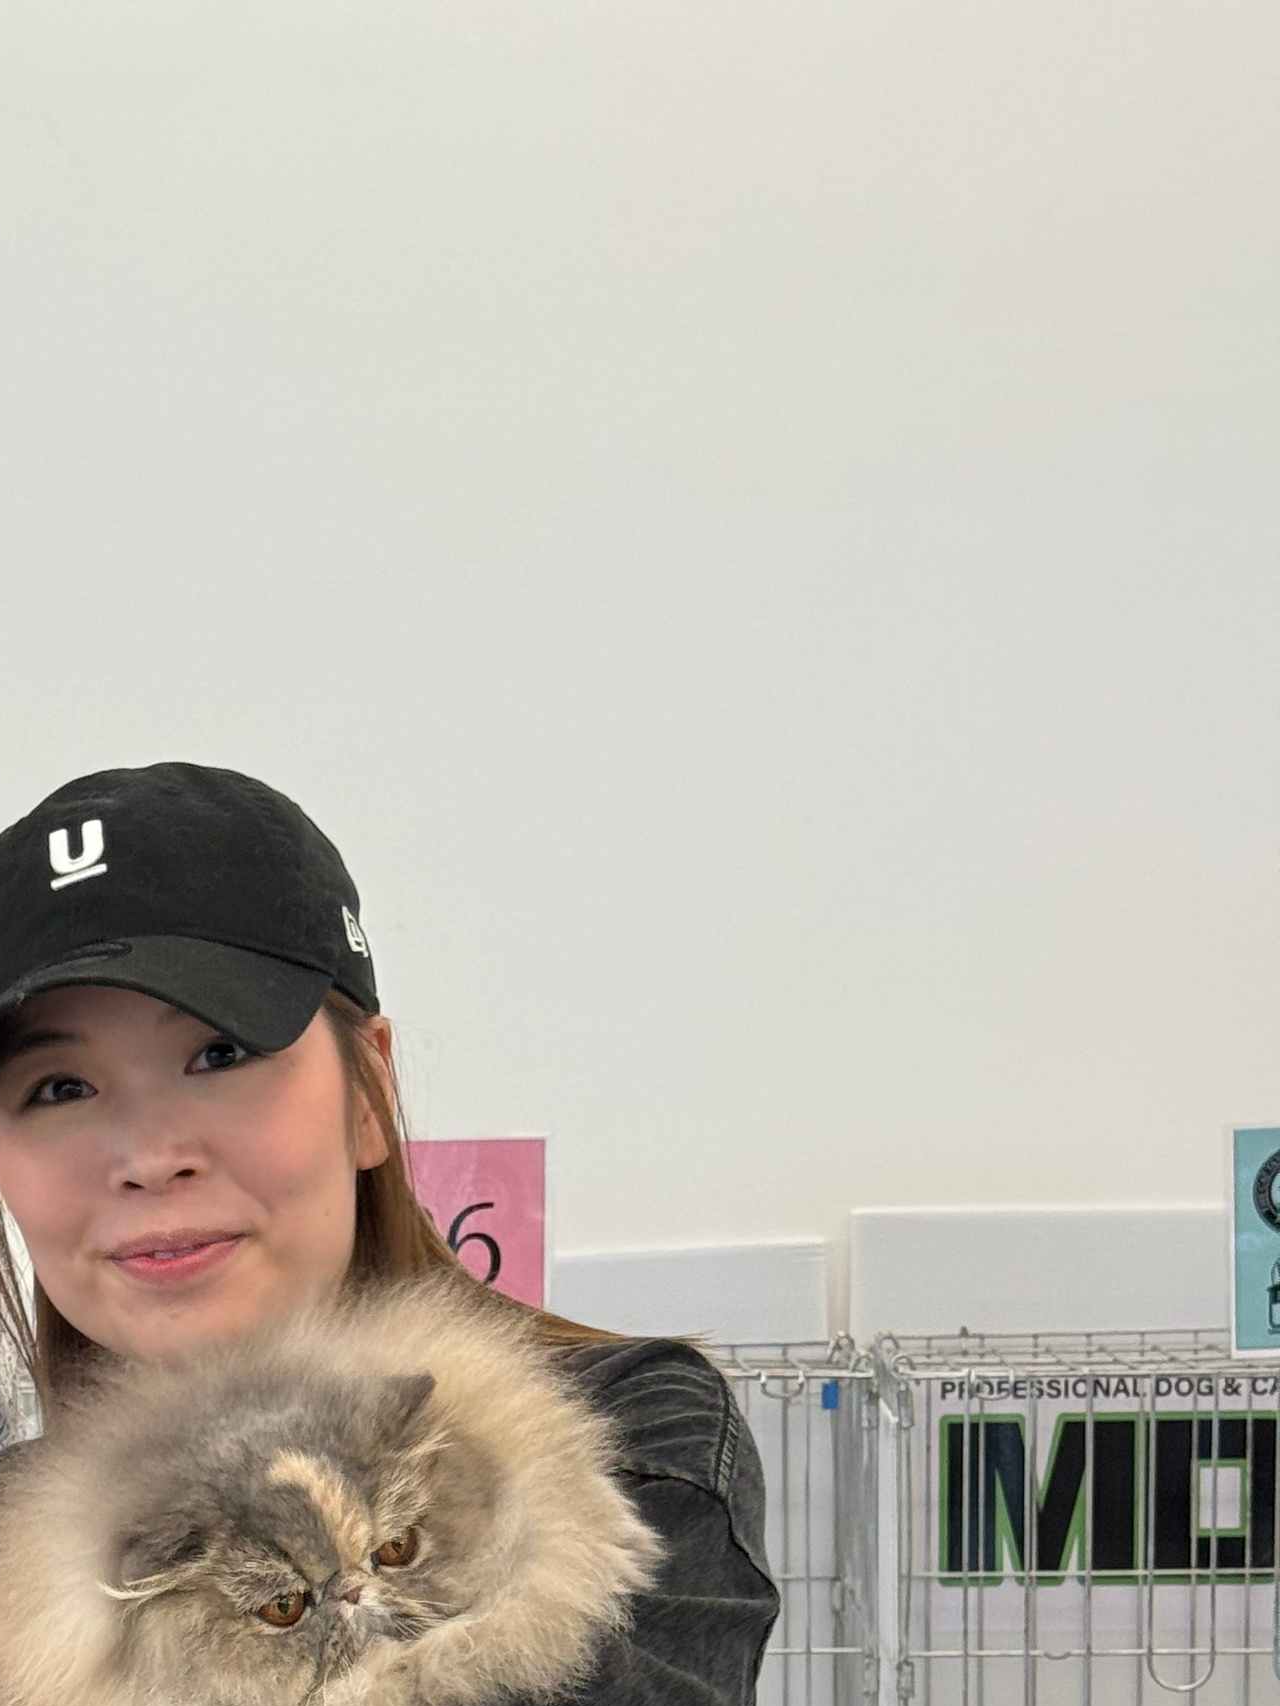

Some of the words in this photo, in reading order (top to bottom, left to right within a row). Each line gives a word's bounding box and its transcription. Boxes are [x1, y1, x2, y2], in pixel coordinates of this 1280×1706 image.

[49, 819, 105, 875] U
[1154, 1376, 1214, 1397] DOG
[1222, 1376, 1241, 1397] &
